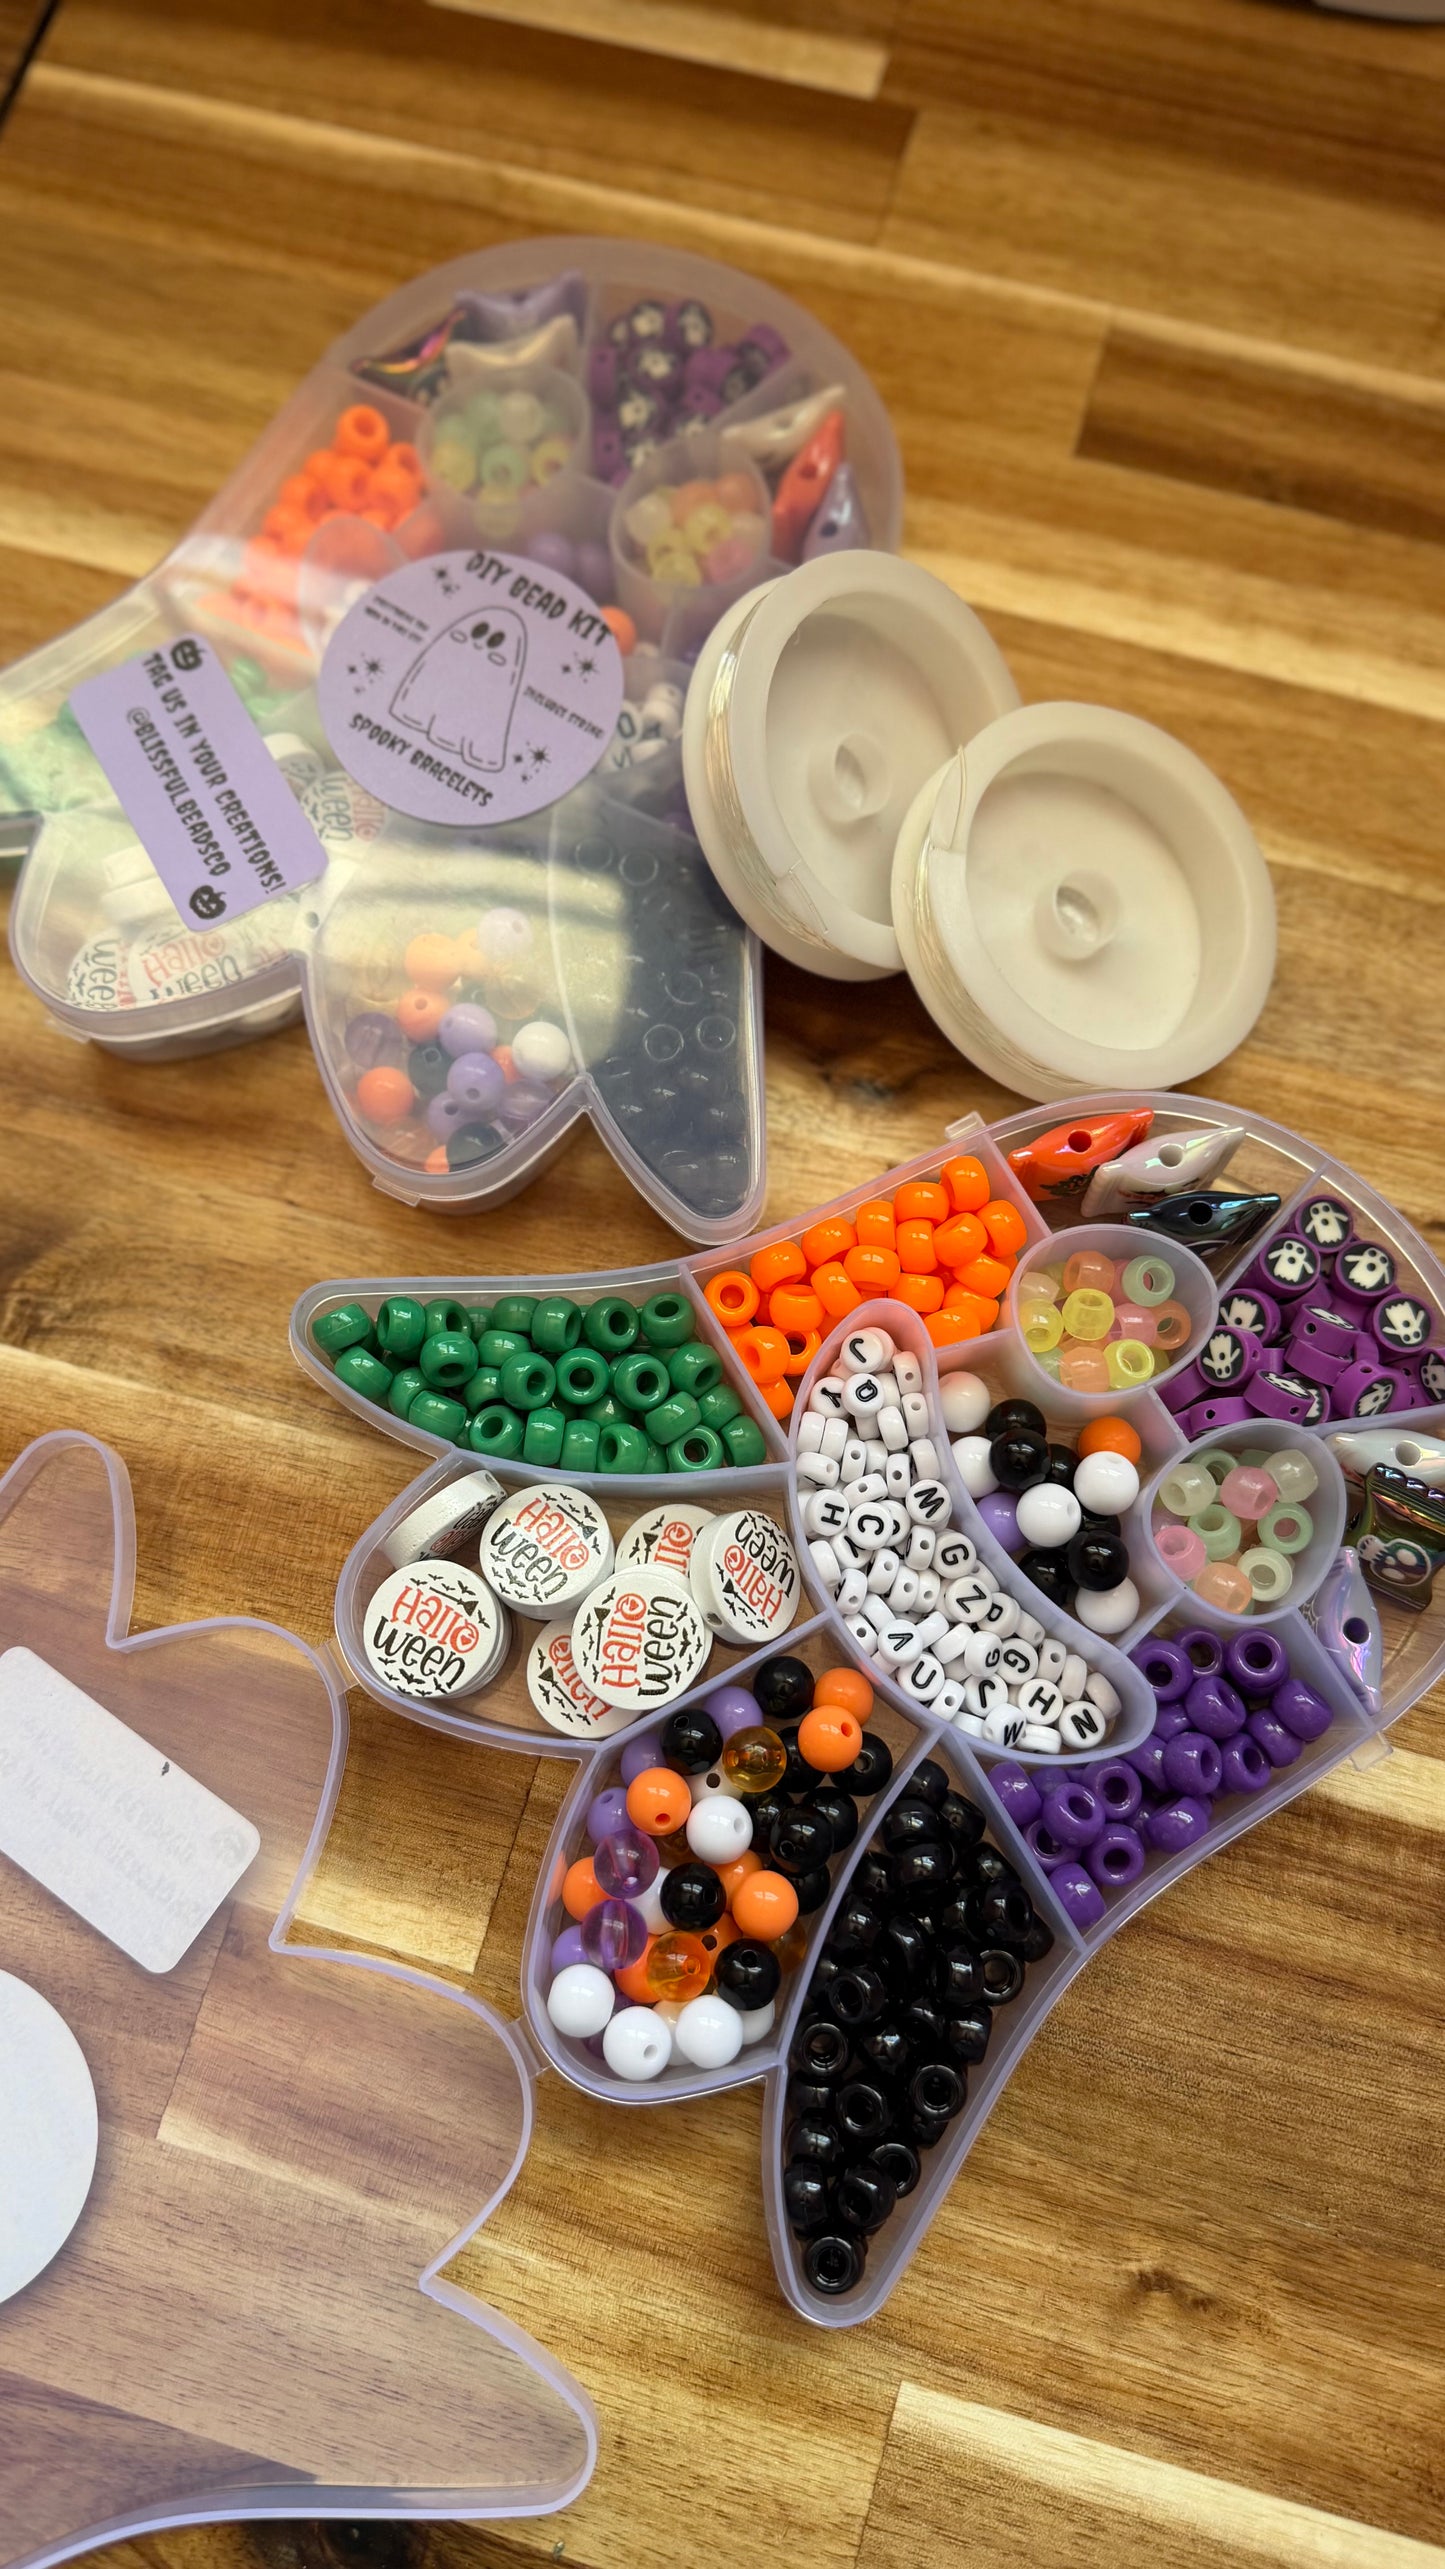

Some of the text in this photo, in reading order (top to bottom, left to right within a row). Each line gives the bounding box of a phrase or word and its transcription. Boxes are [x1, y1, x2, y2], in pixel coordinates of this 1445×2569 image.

[466, 551, 613, 646] DIY BEAD KIT
[142, 652, 287, 895] TAG US IN YOUR CREATIONS!
[349, 713, 494, 807] SPOOKY BRACELETS
[490, 1518, 568, 1599] ween
[512, 1497, 589, 1571] Hallo
[735, 1516, 795, 1599] ween
[390, 1585, 479, 1654] Hallo
[724, 1545, 784, 1622] Hallo
[373, 1615, 466, 1689] ween
[601, 1593, 647, 1688] Hallo
[638, 1596, 682, 1696] ween
